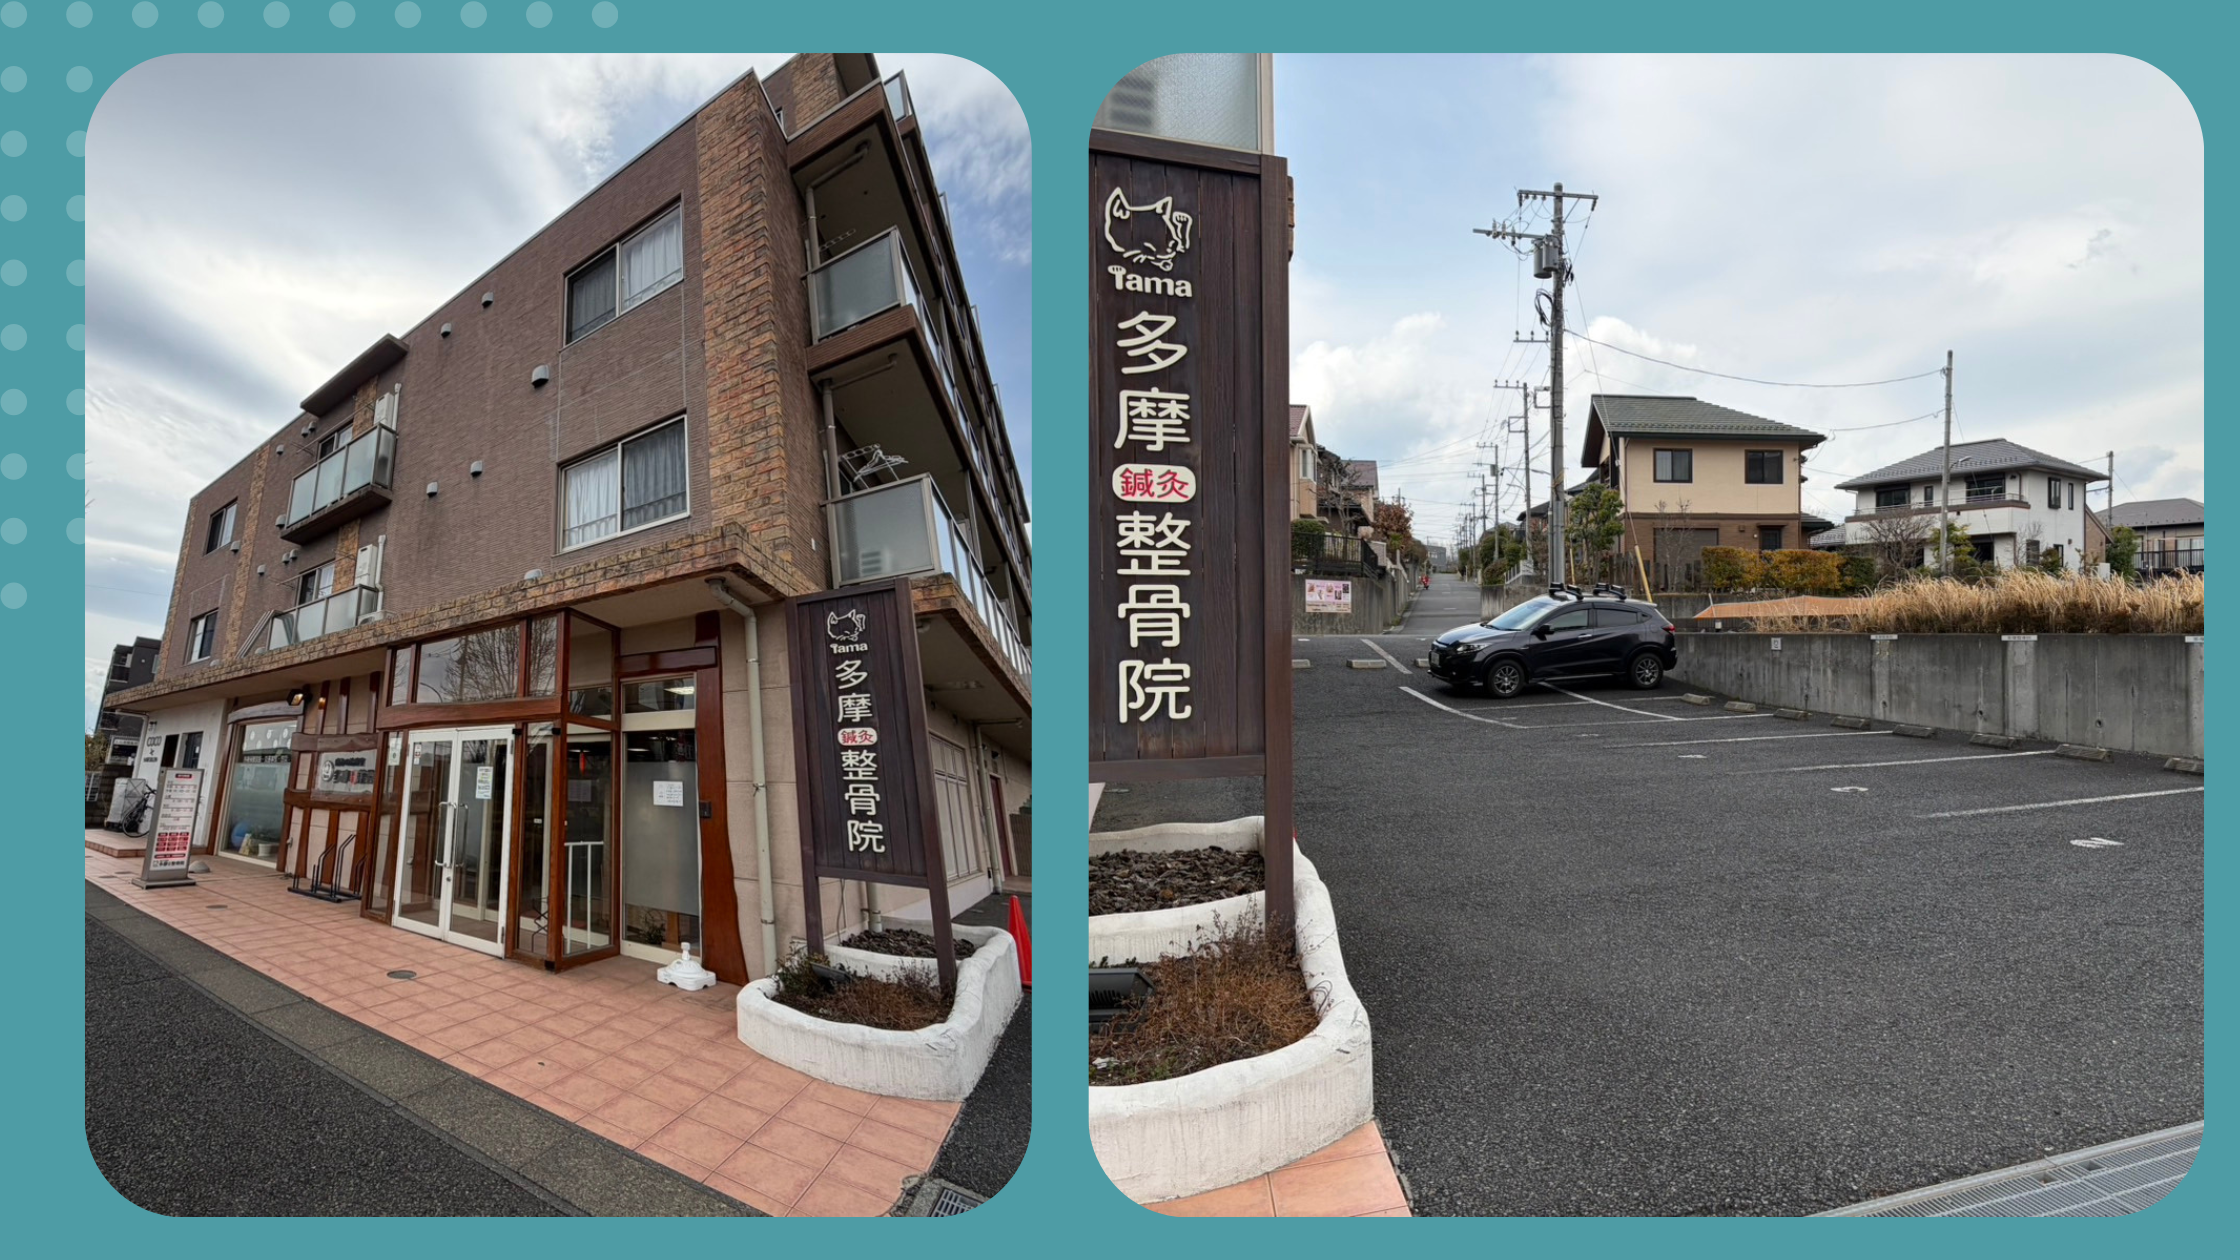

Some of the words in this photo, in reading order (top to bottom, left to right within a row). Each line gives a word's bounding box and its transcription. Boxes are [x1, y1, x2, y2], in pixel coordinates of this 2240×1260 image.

[1108, 264, 1193, 297] Tama
[1120, 467, 1190, 501] 鍼灸
[830, 643, 868, 654] Tama
[840, 730, 875, 745] 鍼灸
